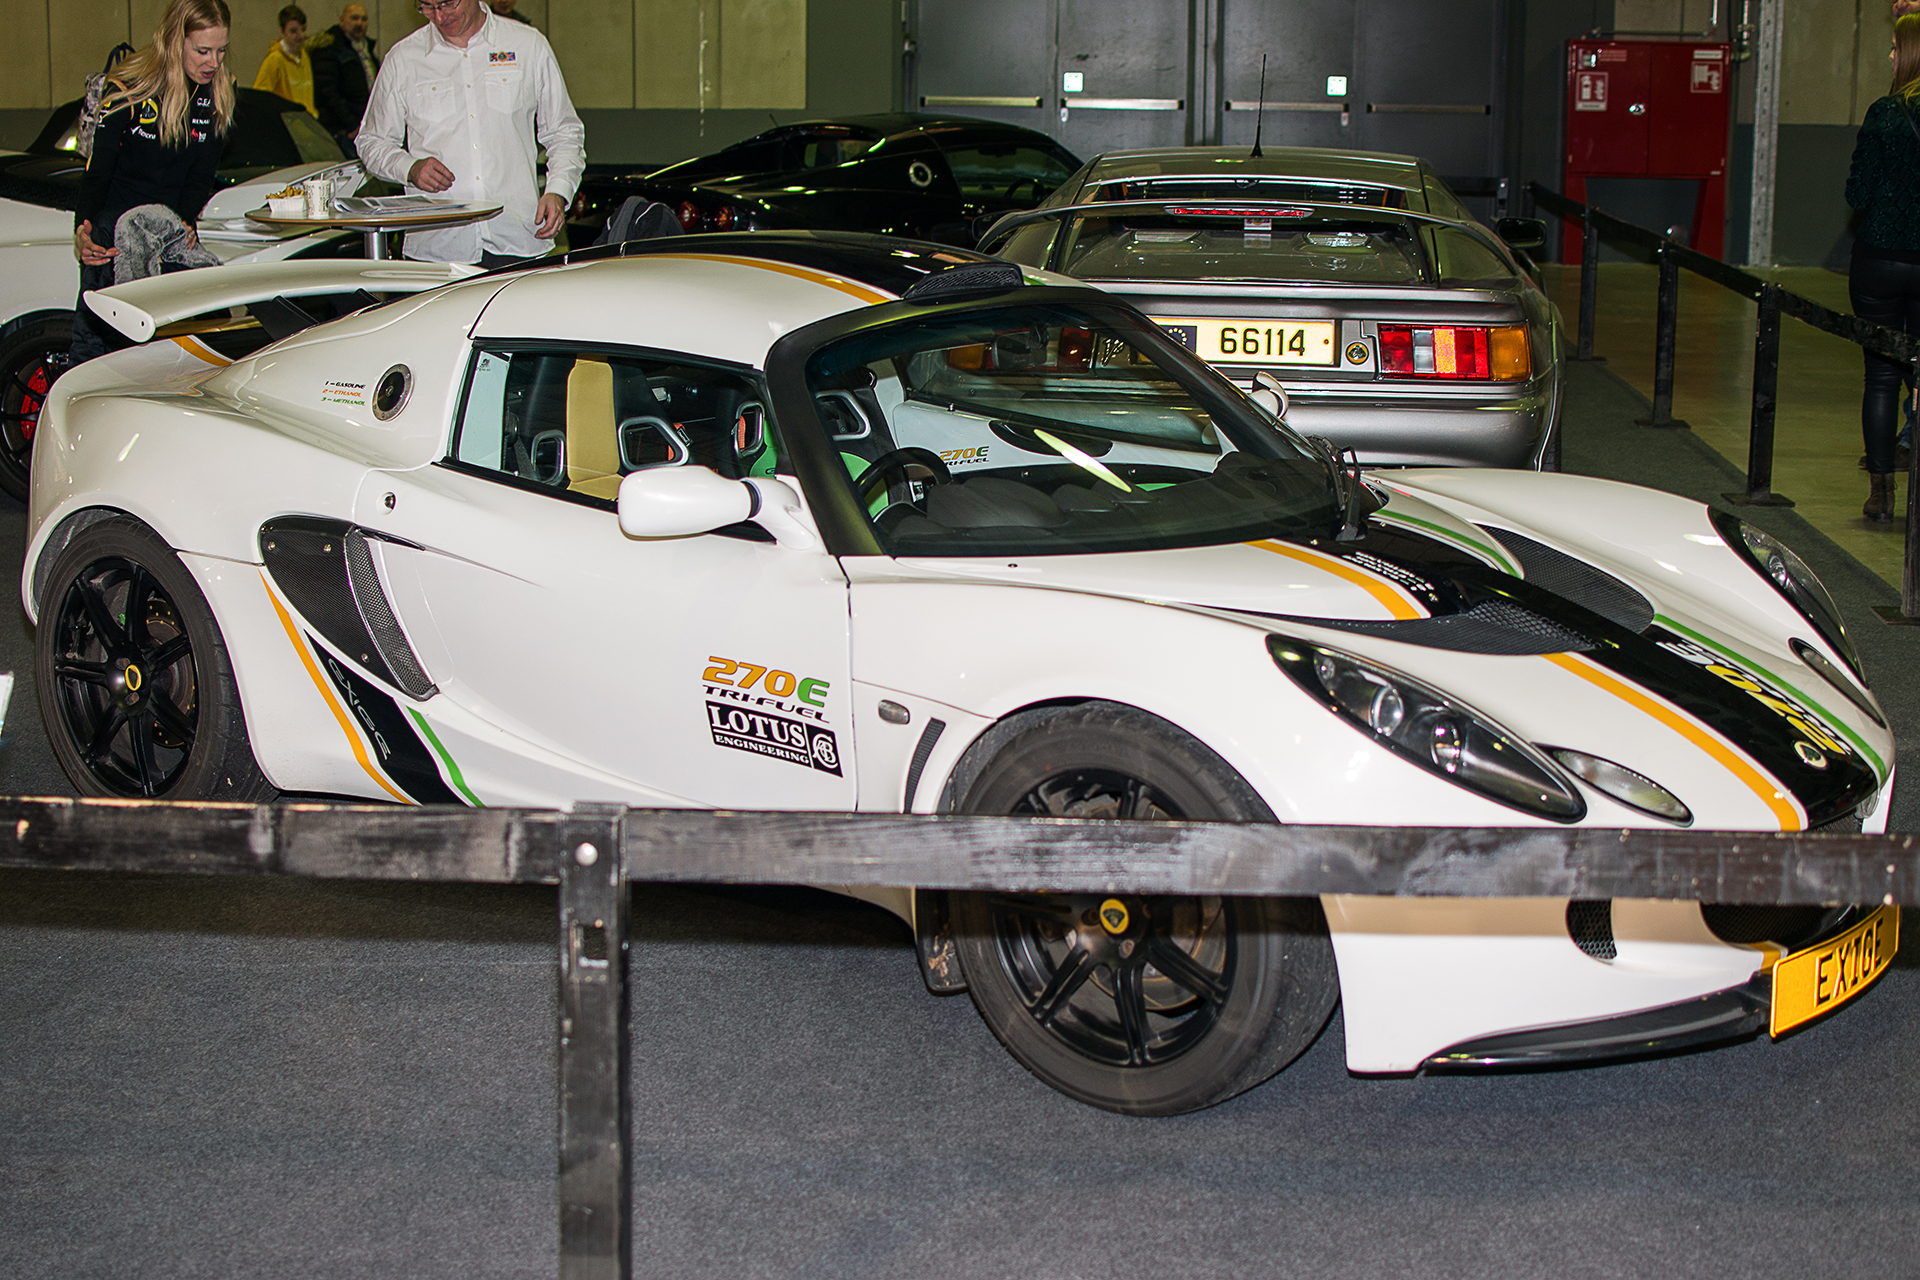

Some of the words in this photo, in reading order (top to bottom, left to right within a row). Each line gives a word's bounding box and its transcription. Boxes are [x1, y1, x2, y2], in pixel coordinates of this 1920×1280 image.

[1220, 327, 1305, 356] 66114
[333, 398, 365, 406] METHANOL
[940, 446, 990, 461] 270E
[945, 457, 990, 466] RI-FUEL
[702, 655, 830, 708] 270E
[702, 684, 830, 724] TRI-FUEL
[708, 705, 806, 748] LOTUS
[714, 735, 809, 764] ENGINEERING
[1814, 915, 1884, 1008] EXIGE
